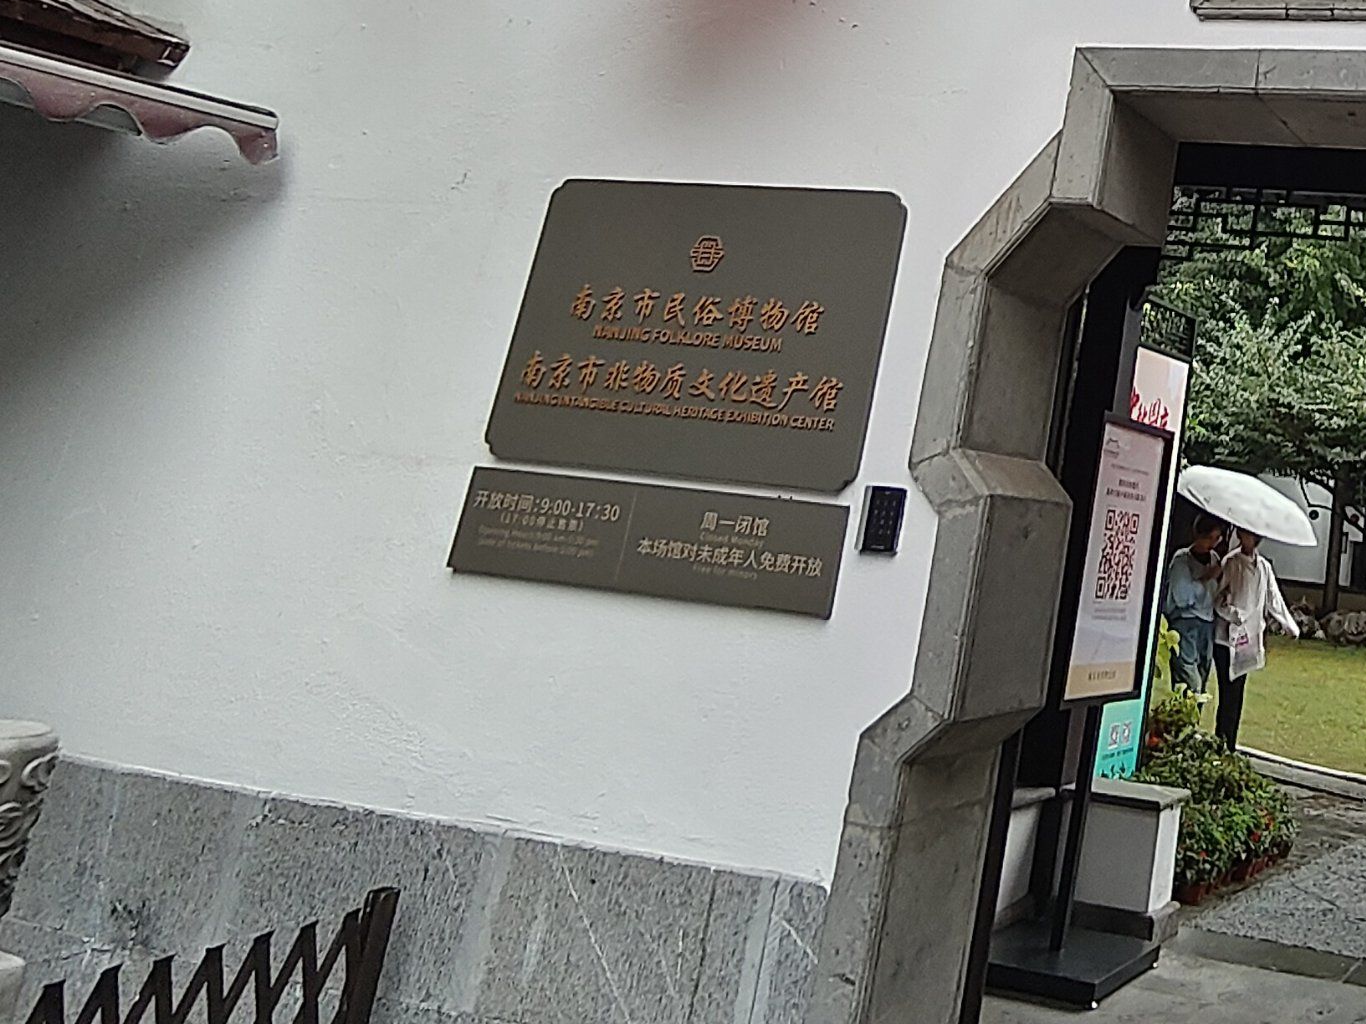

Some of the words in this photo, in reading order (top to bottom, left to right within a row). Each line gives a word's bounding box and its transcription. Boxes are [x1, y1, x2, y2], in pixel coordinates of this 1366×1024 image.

[570, 283, 824, 334] 南京市民俗博物馆
[592, 324, 651, 342] NANJING
[652, 328, 720, 348] FOLKLORE
[722, 334, 783, 352] MUSEUM
[522, 350, 843, 412] 南京市非物质文化遗产馆
[673, 405, 724, 421] HERITAGE
[790, 415, 835, 432] CENTER
[700, 511, 769, 537] 周一闭馆
[637, 538, 822, 576] 本场馆对未成年人免费开放
